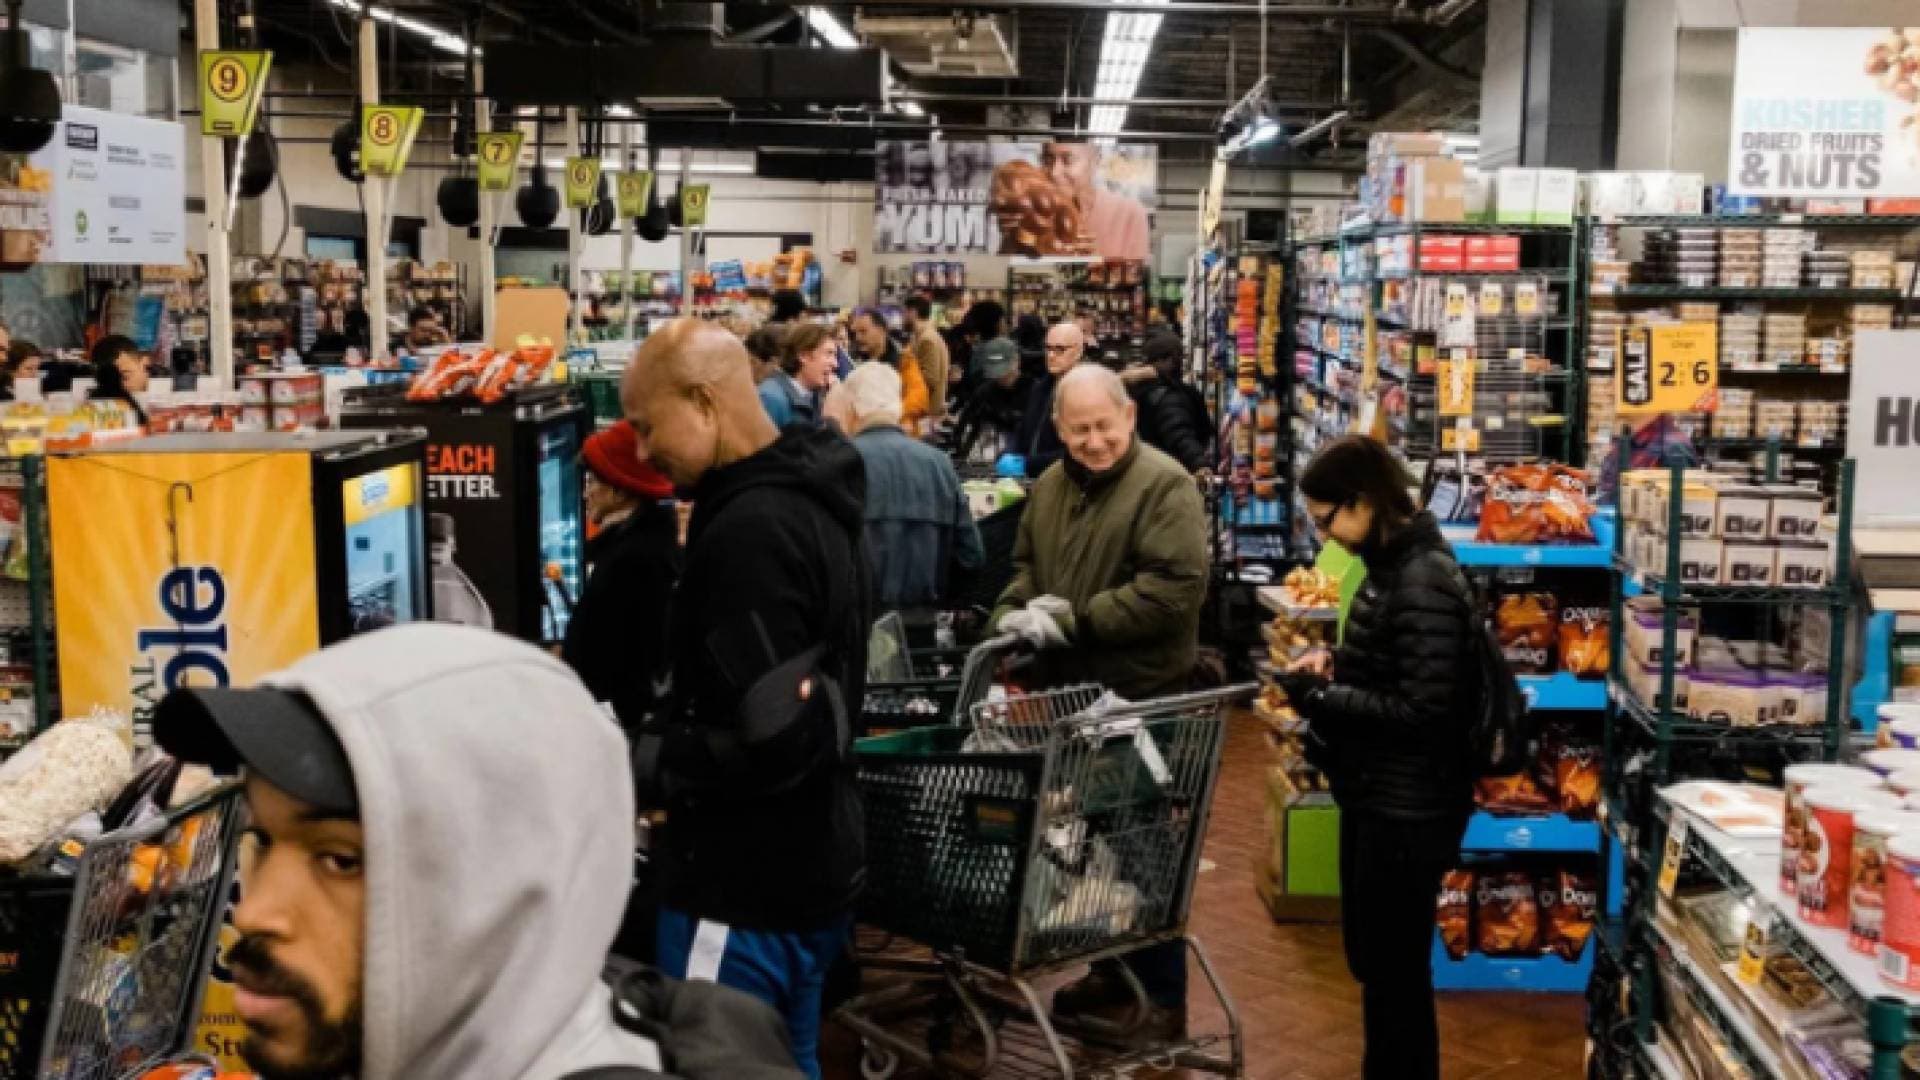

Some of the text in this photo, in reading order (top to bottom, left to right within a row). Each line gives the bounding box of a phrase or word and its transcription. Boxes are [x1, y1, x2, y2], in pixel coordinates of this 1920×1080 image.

[220, 66, 238, 92] 9
[1743, 99, 1886, 130] KOSHER
[376, 116, 391, 140] 8
[492, 142, 503, 164] 7
[1741, 132, 1883, 152] DRIED FRUITS
[1739, 152, 1881, 189] & NUTS
[1659, 361, 1678, 387] 2
[1693, 360, 1710, 385] 6
[1874, 396, 1920, 446] H
